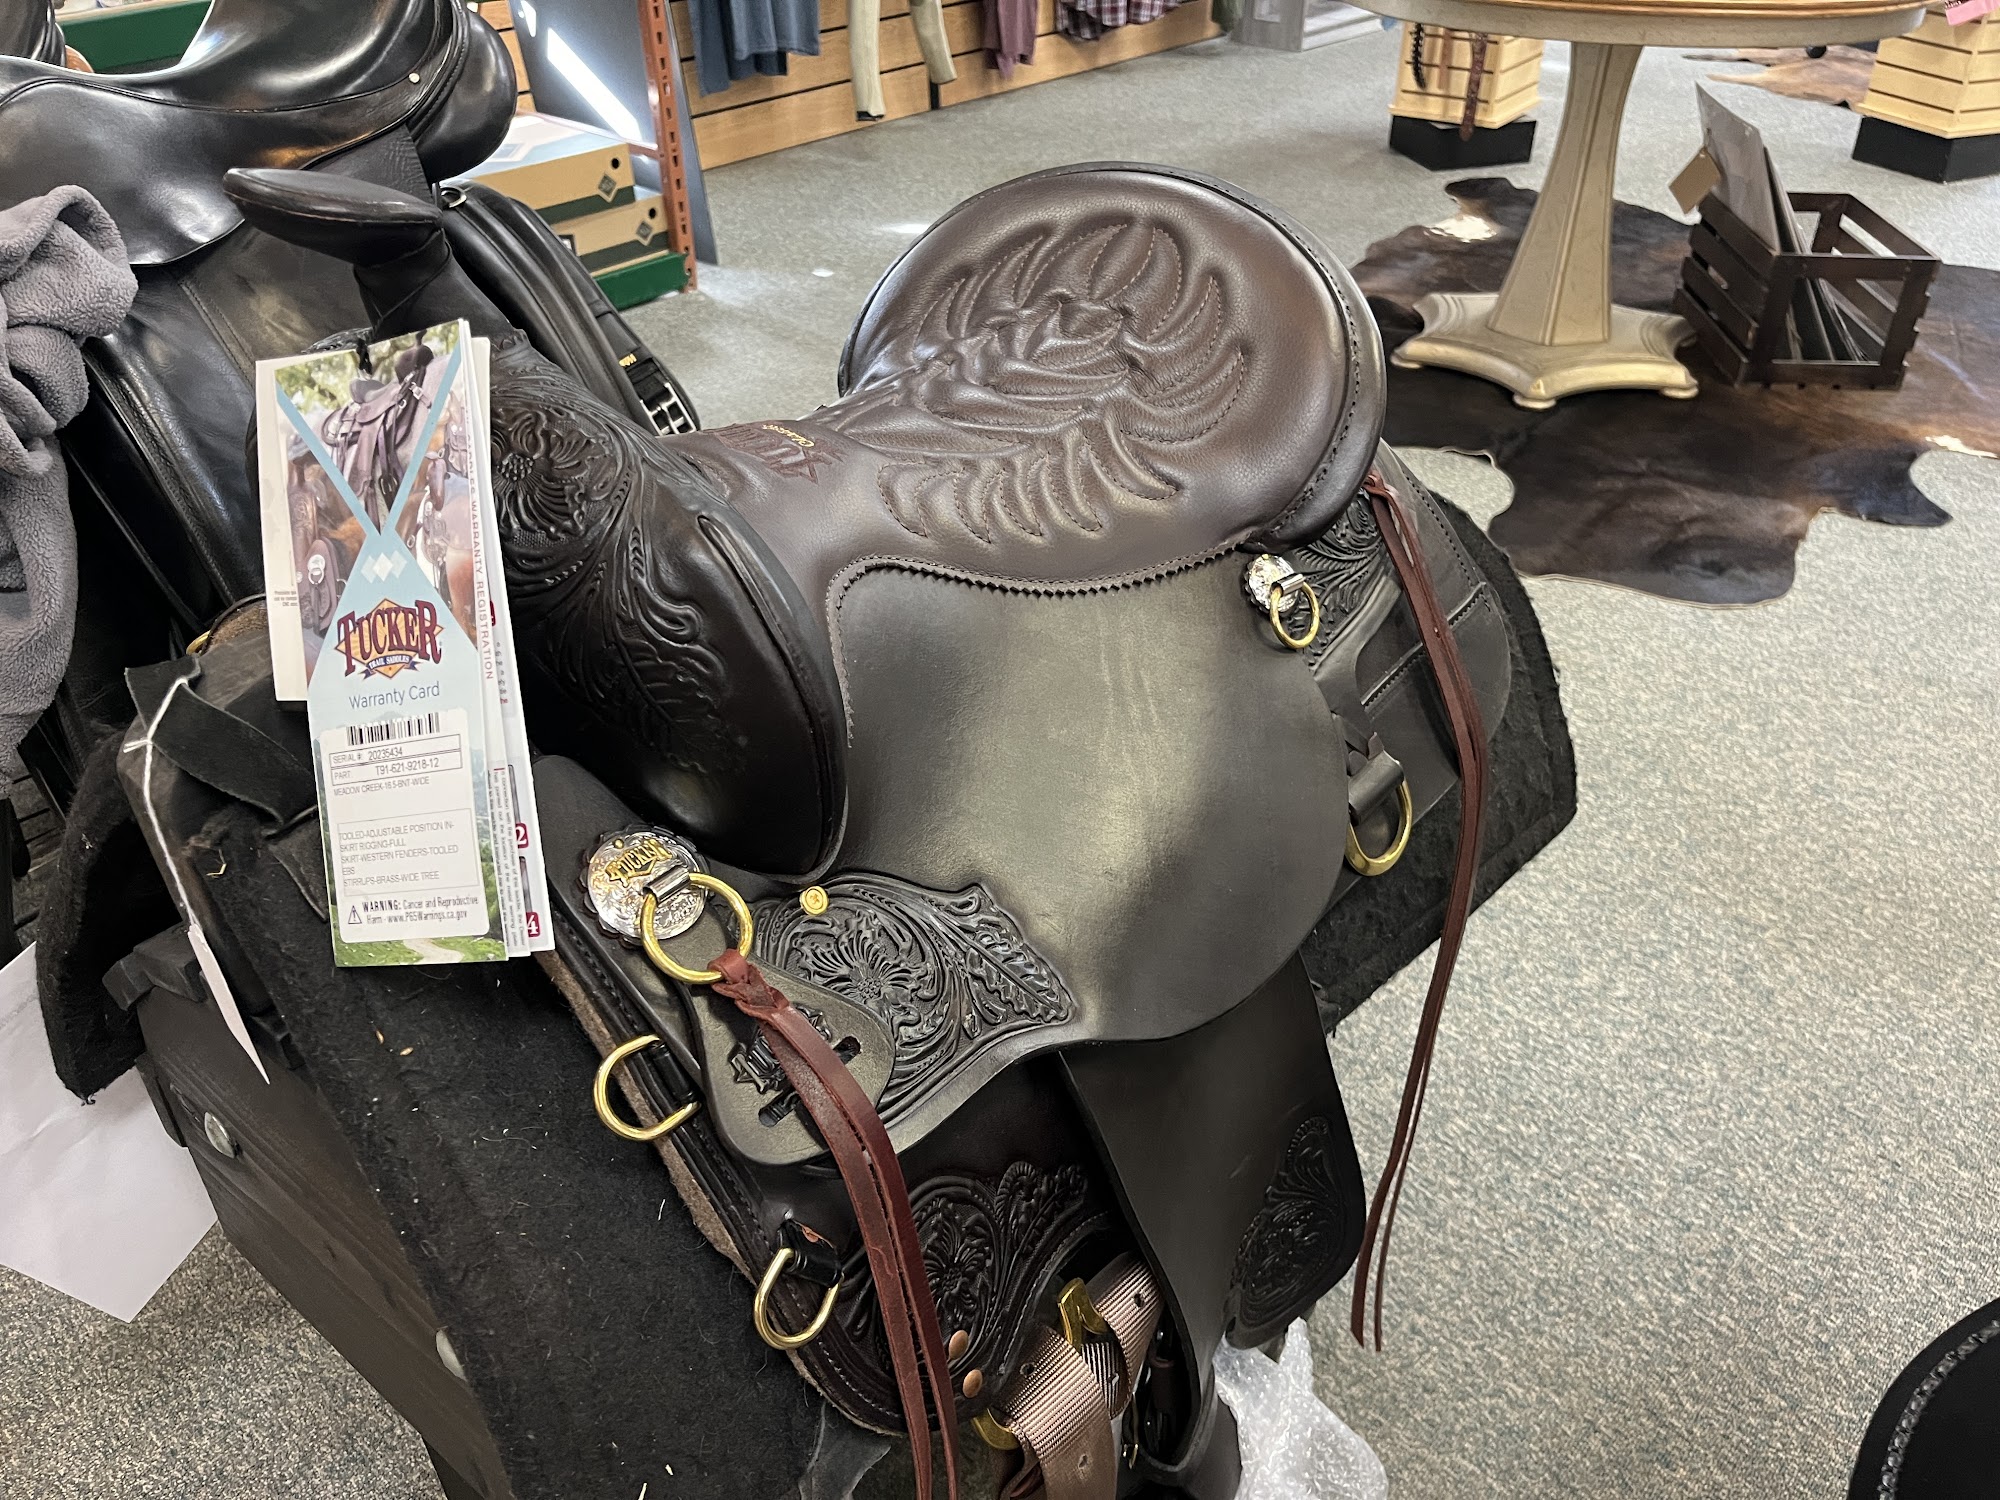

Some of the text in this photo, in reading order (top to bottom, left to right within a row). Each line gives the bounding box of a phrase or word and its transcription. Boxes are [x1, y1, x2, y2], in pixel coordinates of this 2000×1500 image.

[471, 505, 483, 574] WARRANTY
[337, 600, 442, 677] TUCKER
[476, 581, 494, 680] REGISTRATION
[369, 654, 410, 669] TRAIL SADDLES
[349, 681, 440, 709] Warranty Card
[333, 753, 356, 764] SERIAL
[368, 747, 402, 761] 20235434
[375, 757, 439, 776] T91-621-9218-12
[333, 786, 361, 796] MEADOW
[339, 820, 455, 841] TOOLED-ADJUSTABLE POSITION IN-
[516, 826, 526, 845] 2
[340, 838, 406, 852] SKIRT RIGGING-FULL
[341, 844, 459, 864] SKIRT-WESTERN FENDERS-TOOLED
[343, 870, 440, 887] STIRRUPS-BRASS-WIDE TREE
[362, 893, 480, 912] WARNING: Cancer and Reproductive
[367, 914, 382, 925] Harm
[527, 914, 539, 935] 4
